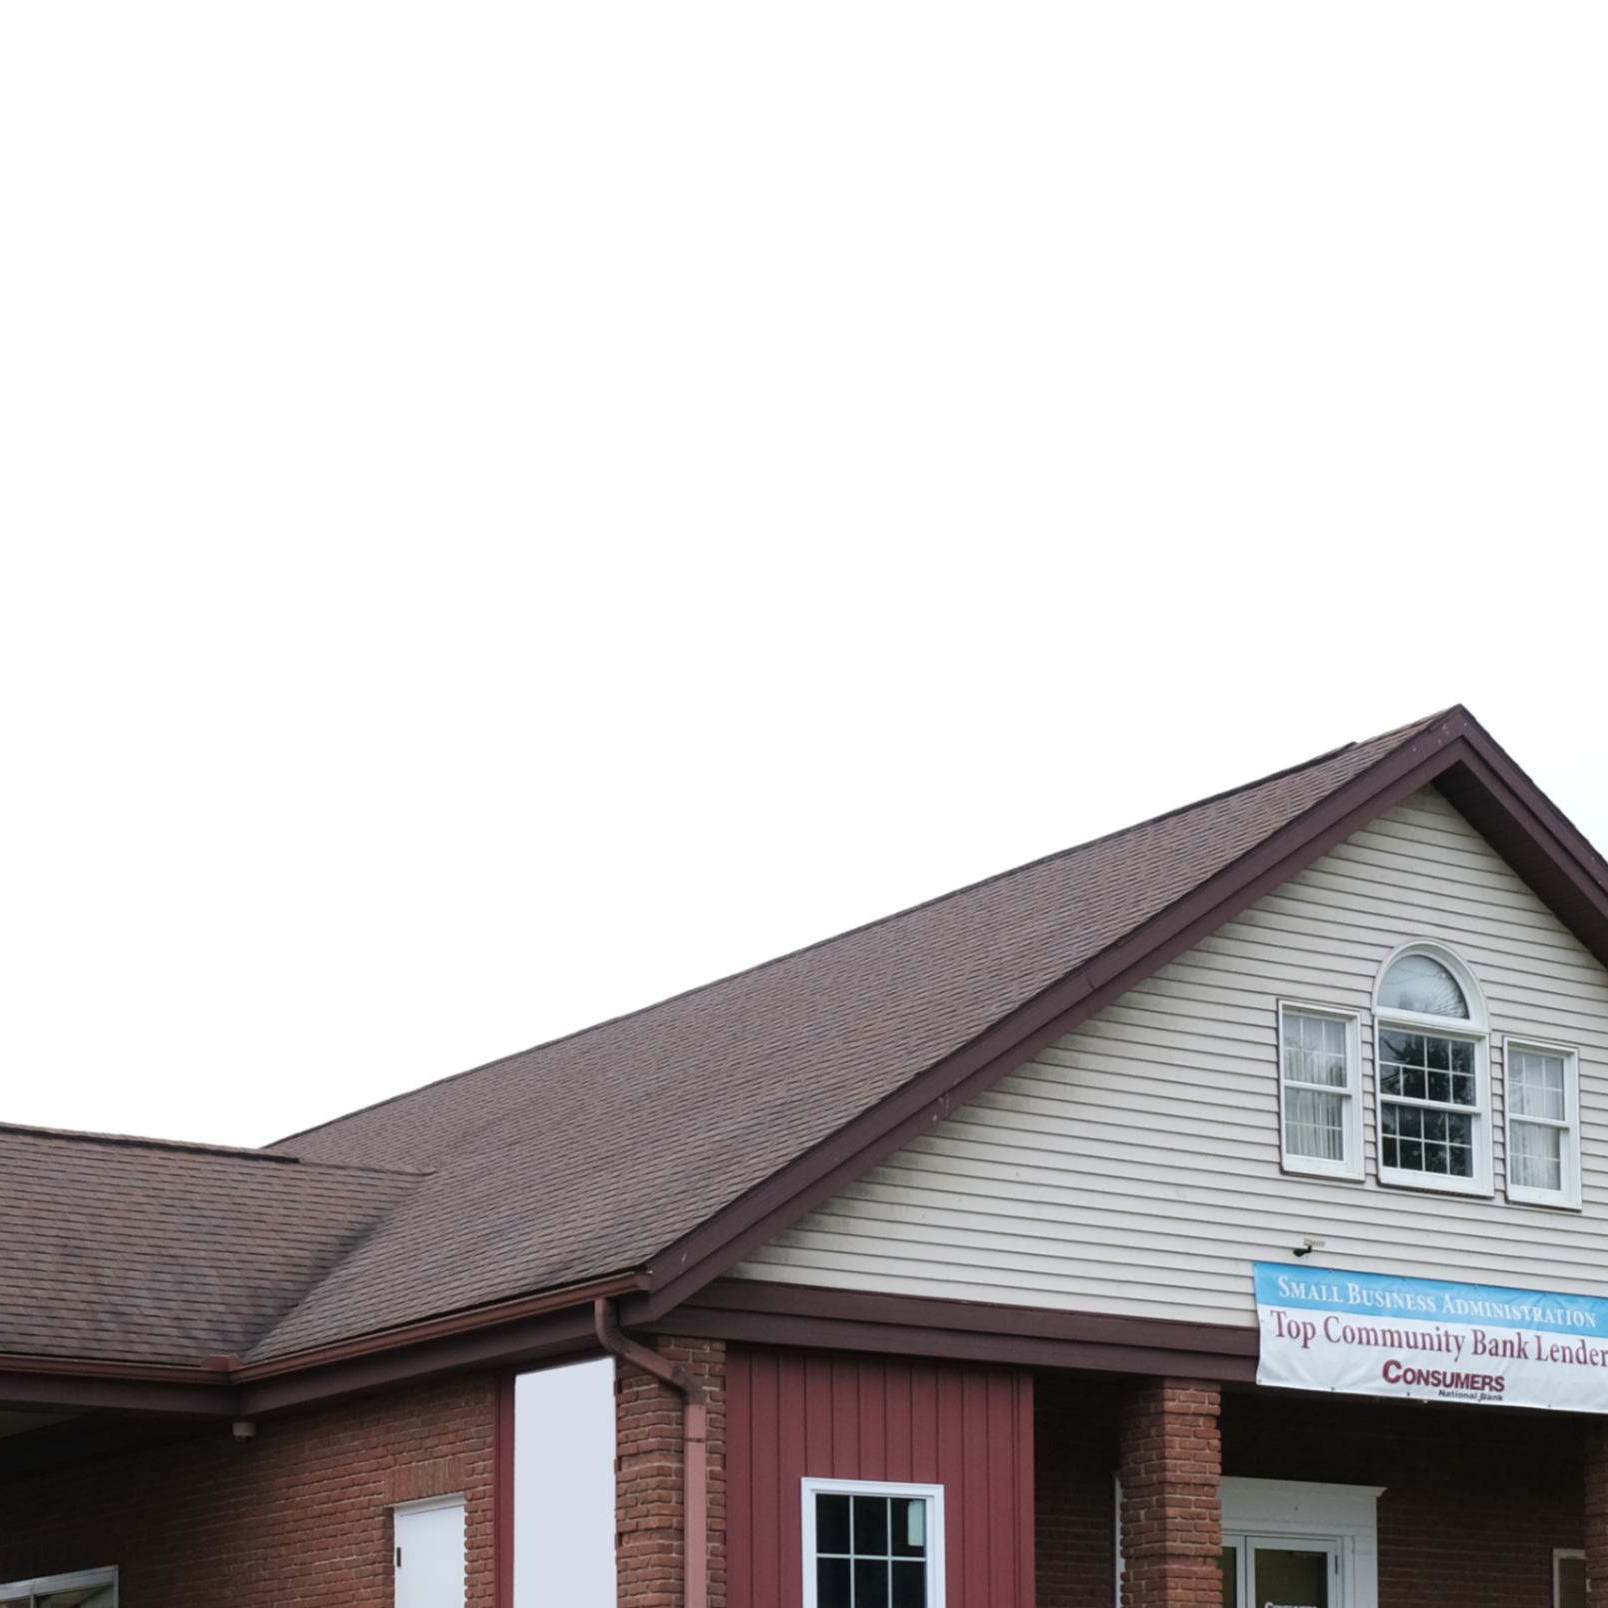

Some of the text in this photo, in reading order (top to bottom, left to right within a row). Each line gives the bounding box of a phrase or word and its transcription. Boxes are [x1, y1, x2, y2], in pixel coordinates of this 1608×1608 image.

[1277, 1275, 1597, 1329] SMALL BUSINESS ADMINISTRATION
[1270, 1309, 1316, 1348] Top
[1323, 1316, 1466, 1362] Community
[1471, 1328, 1529, 1361] Bank
[1382, 1359, 1505, 1393] CONSUMERS
[1438, 1389, 1503, 1401] National Bank
